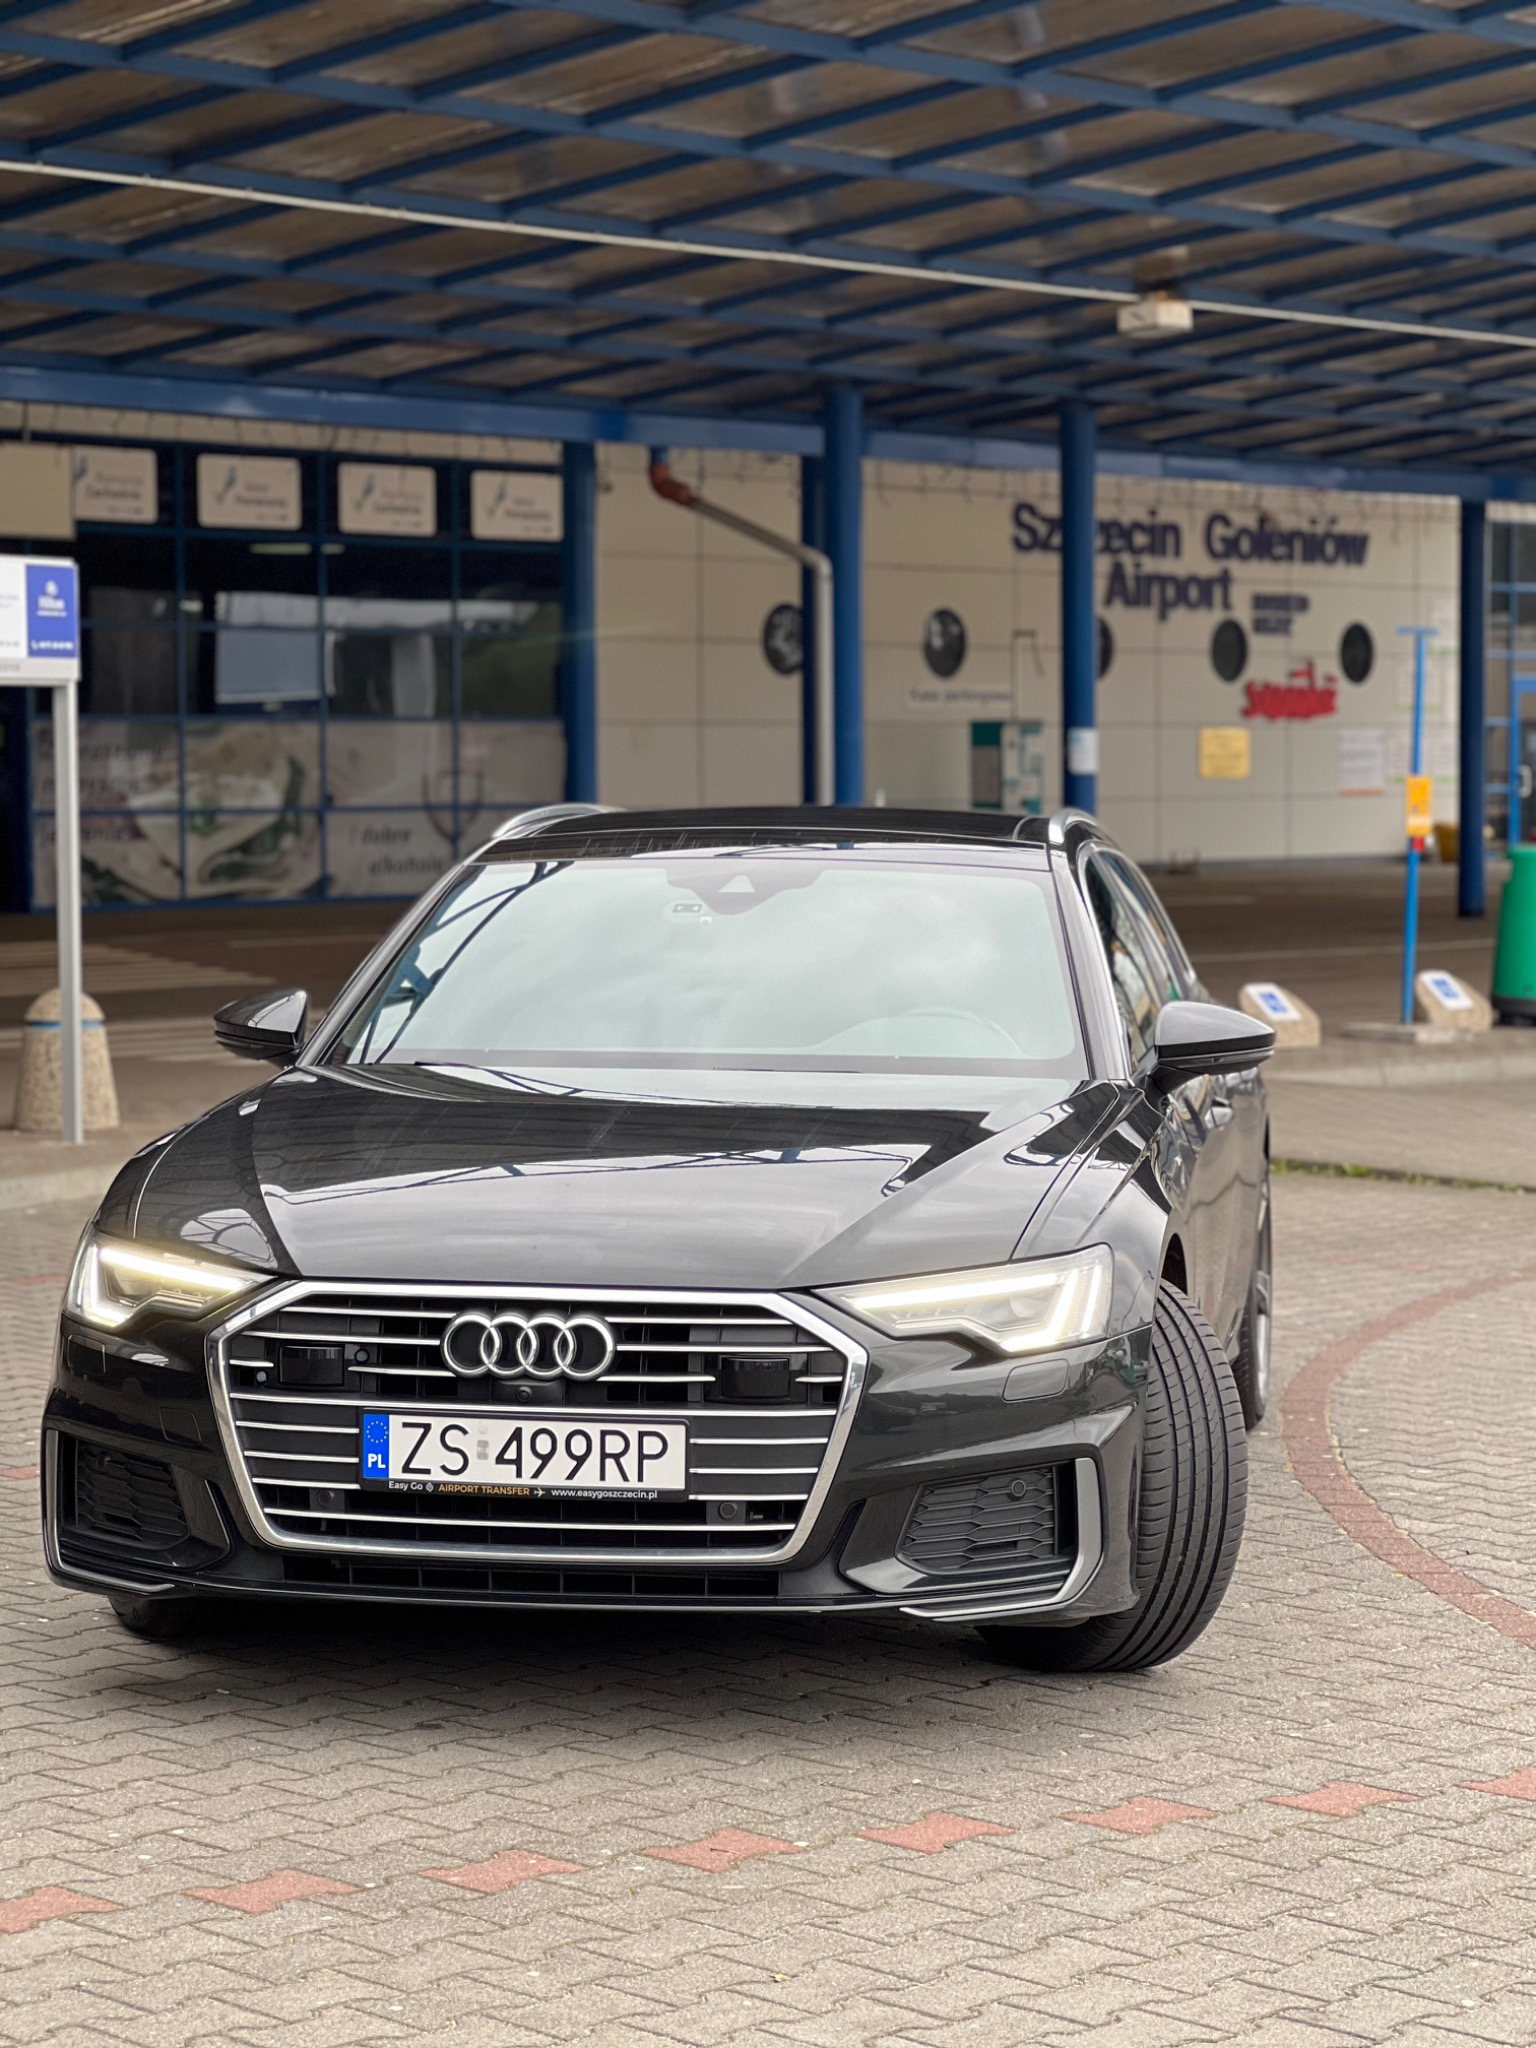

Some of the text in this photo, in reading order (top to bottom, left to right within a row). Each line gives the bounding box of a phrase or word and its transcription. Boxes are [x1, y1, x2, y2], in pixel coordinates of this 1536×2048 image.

[1206, 512, 1369, 566] Goleniów
[1105, 561, 1232, 621] Airport
[367, 1453, 386, 1469] PL
[401, 1421, 669, 1483] ZS 499RP
[389, 1481, 658, 1500] Easy Go AIRPORT TRANSFER www.easygoszczecin.pl
